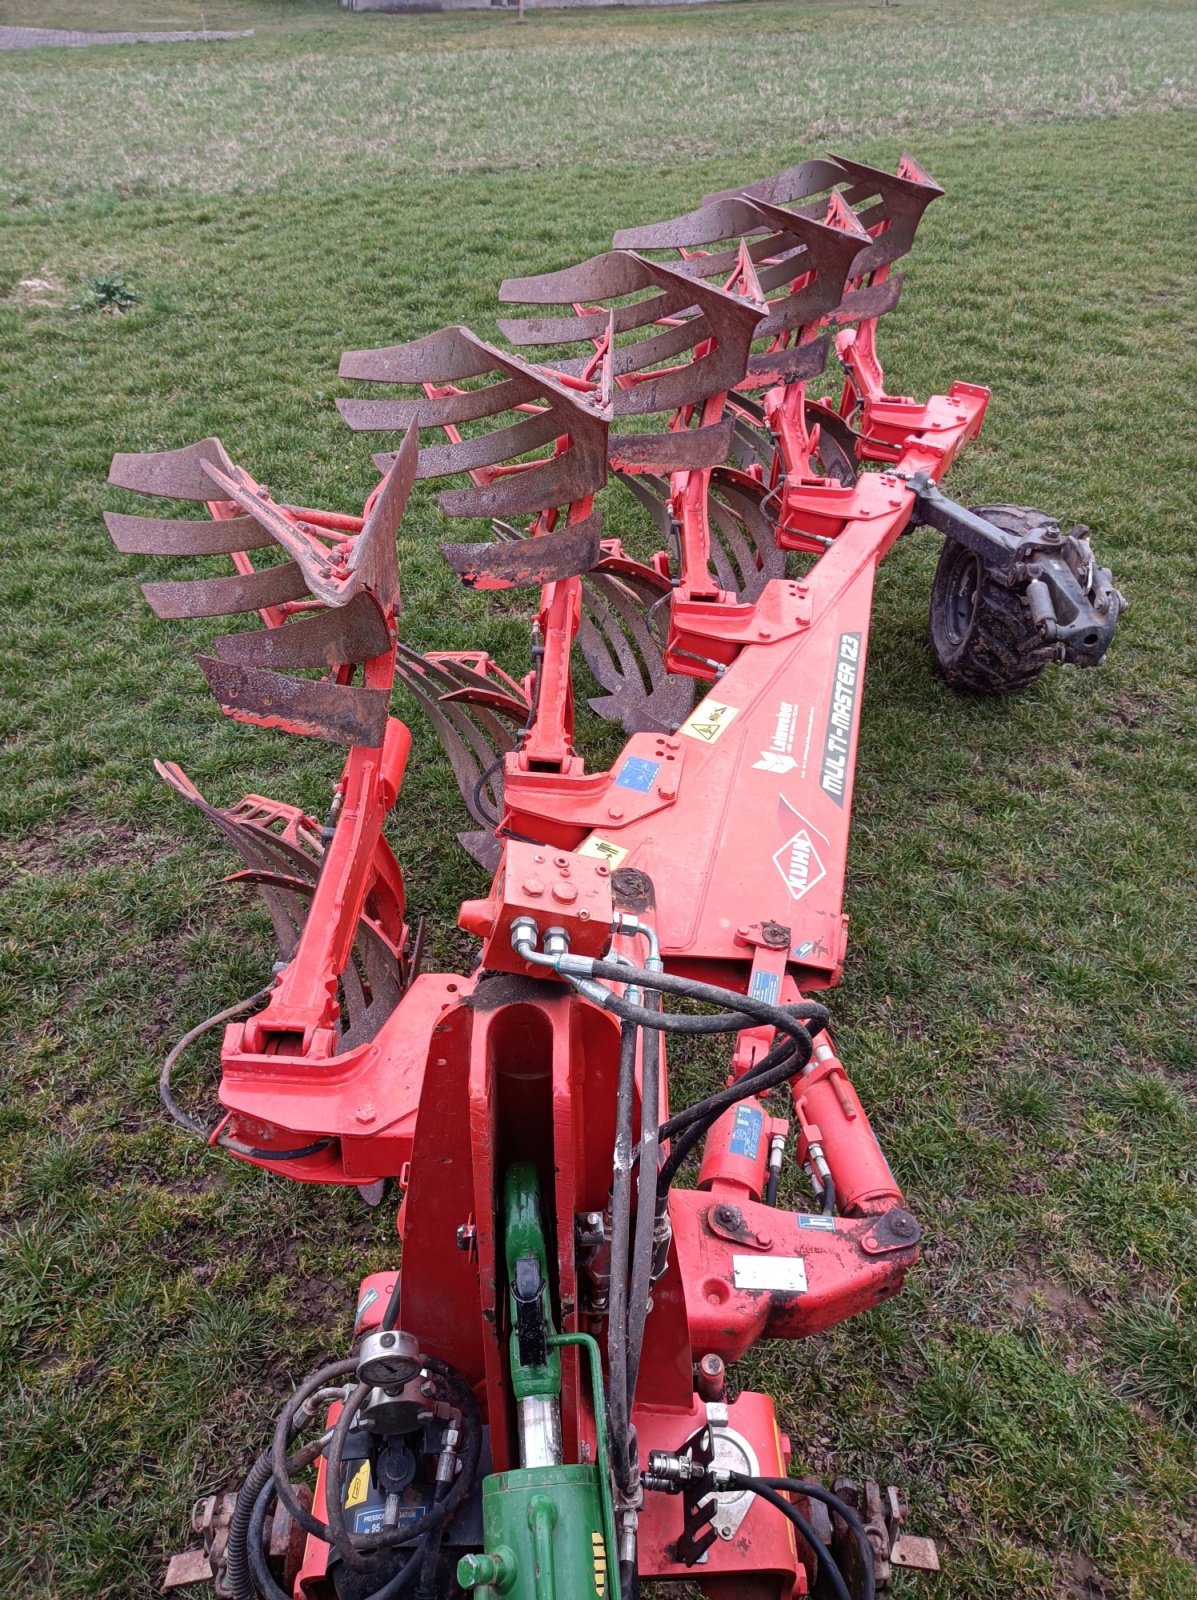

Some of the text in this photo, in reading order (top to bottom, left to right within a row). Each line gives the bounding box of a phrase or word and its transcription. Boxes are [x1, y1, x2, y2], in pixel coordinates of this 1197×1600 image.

[822, 634, 859, 796] MULTI-MASTER 123
[788, 838, 811, 891] KUHN
